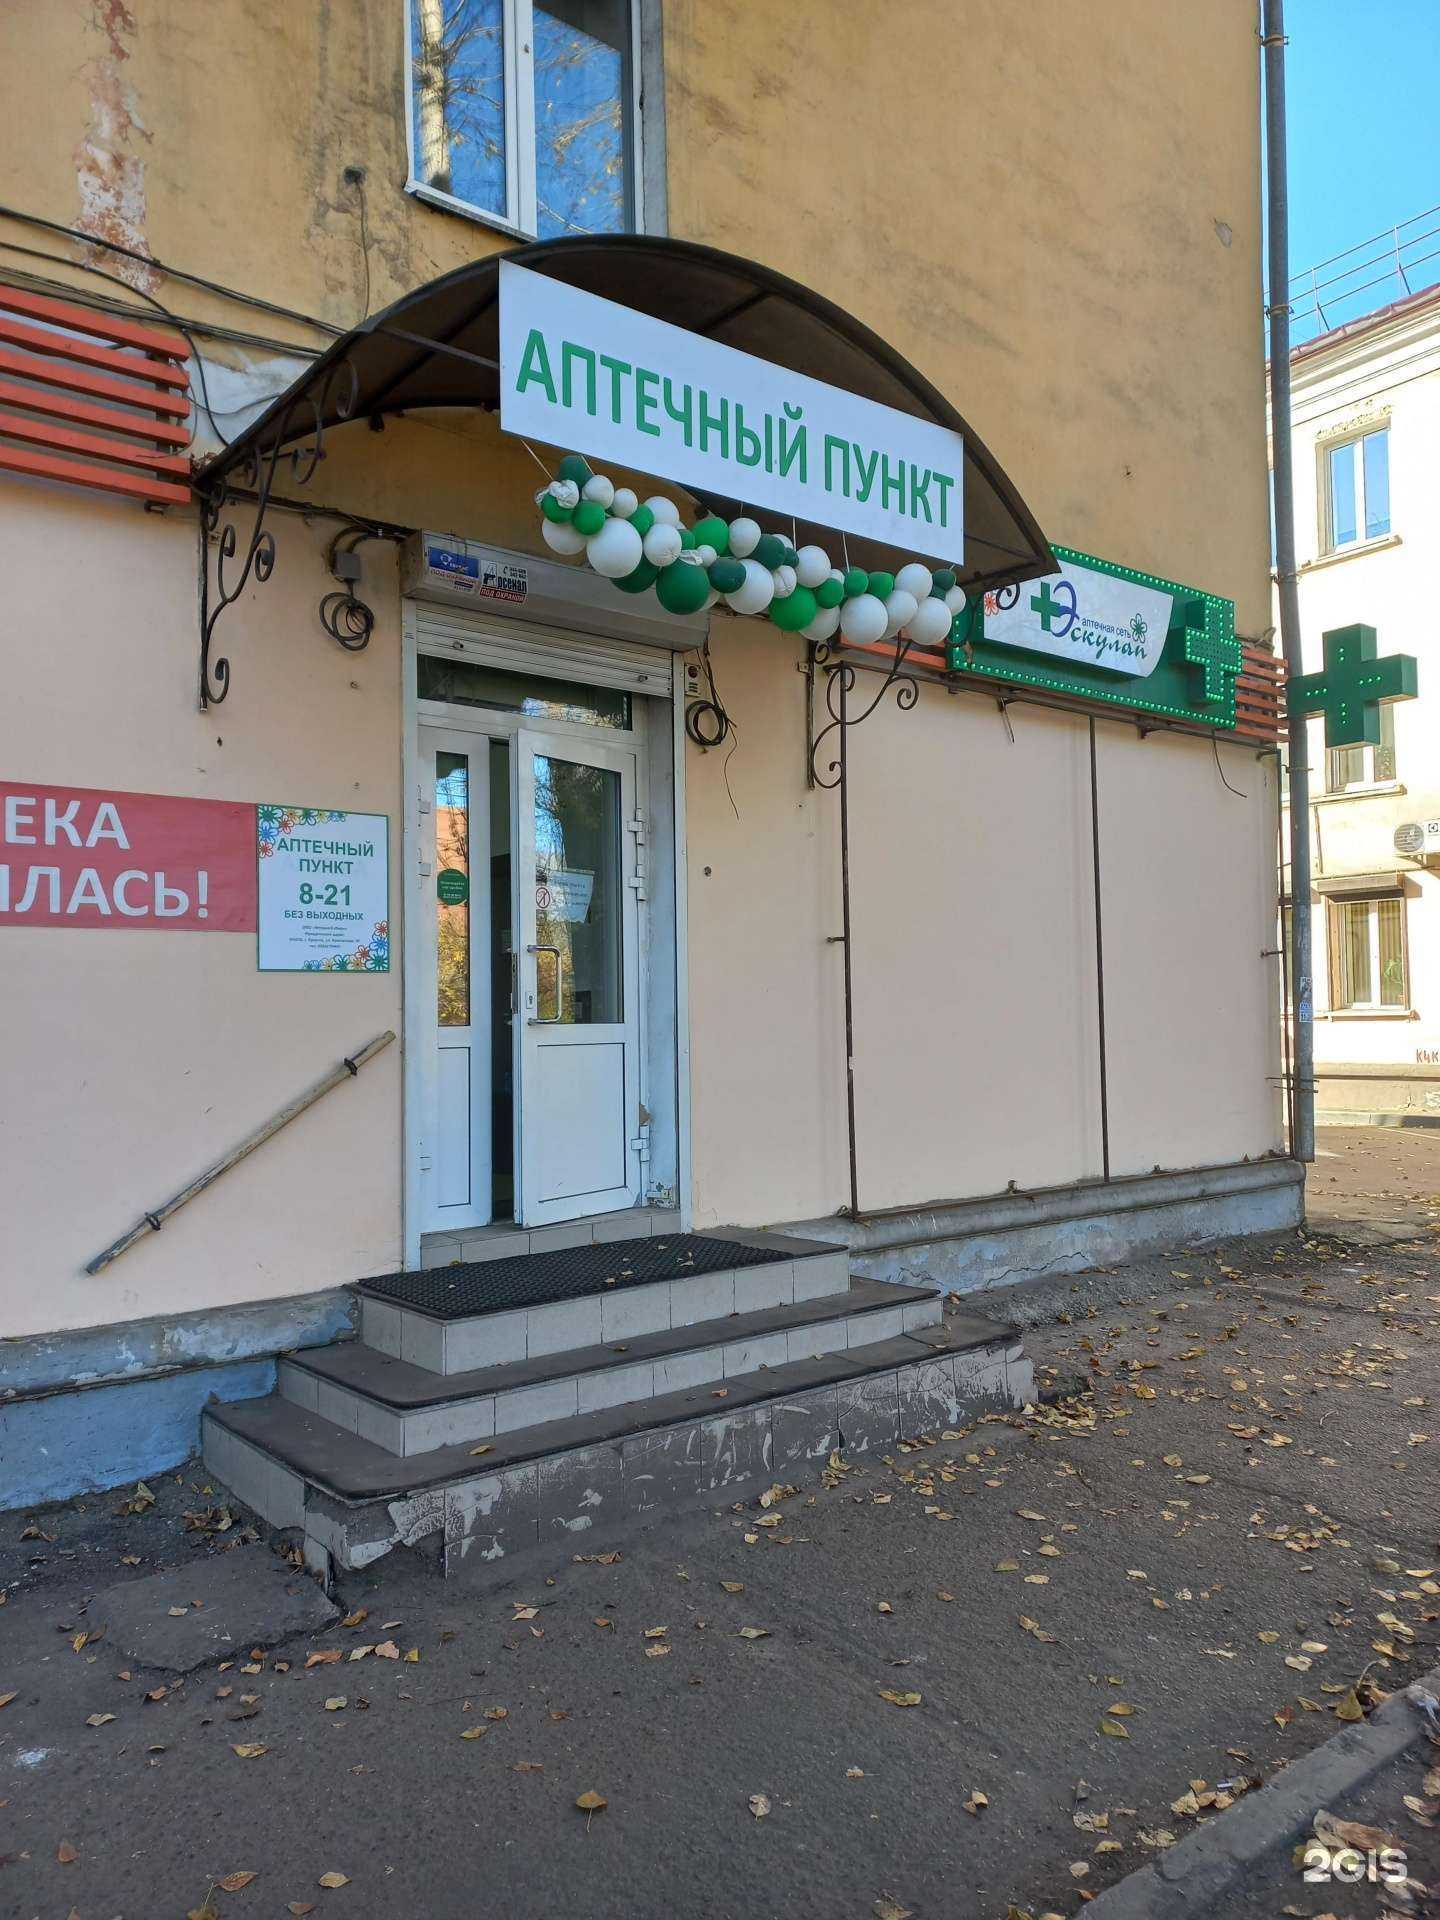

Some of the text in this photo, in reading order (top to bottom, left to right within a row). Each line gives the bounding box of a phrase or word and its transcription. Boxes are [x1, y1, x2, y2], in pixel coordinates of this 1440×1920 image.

[515, 328, 956, 528] АПТЕЧНЫЙ ПУНКТ
[1081, 618, 1132, 639] аптечная сеть
[276, 838, 375, 858] АПТЕЧНЫЙ
[299, 859, 354, 875] ПУНКТ
[299, 882, 351, 906] 8-21
[284, 910, 365, 921] БЕЗ ВЫХОДНЫХ
